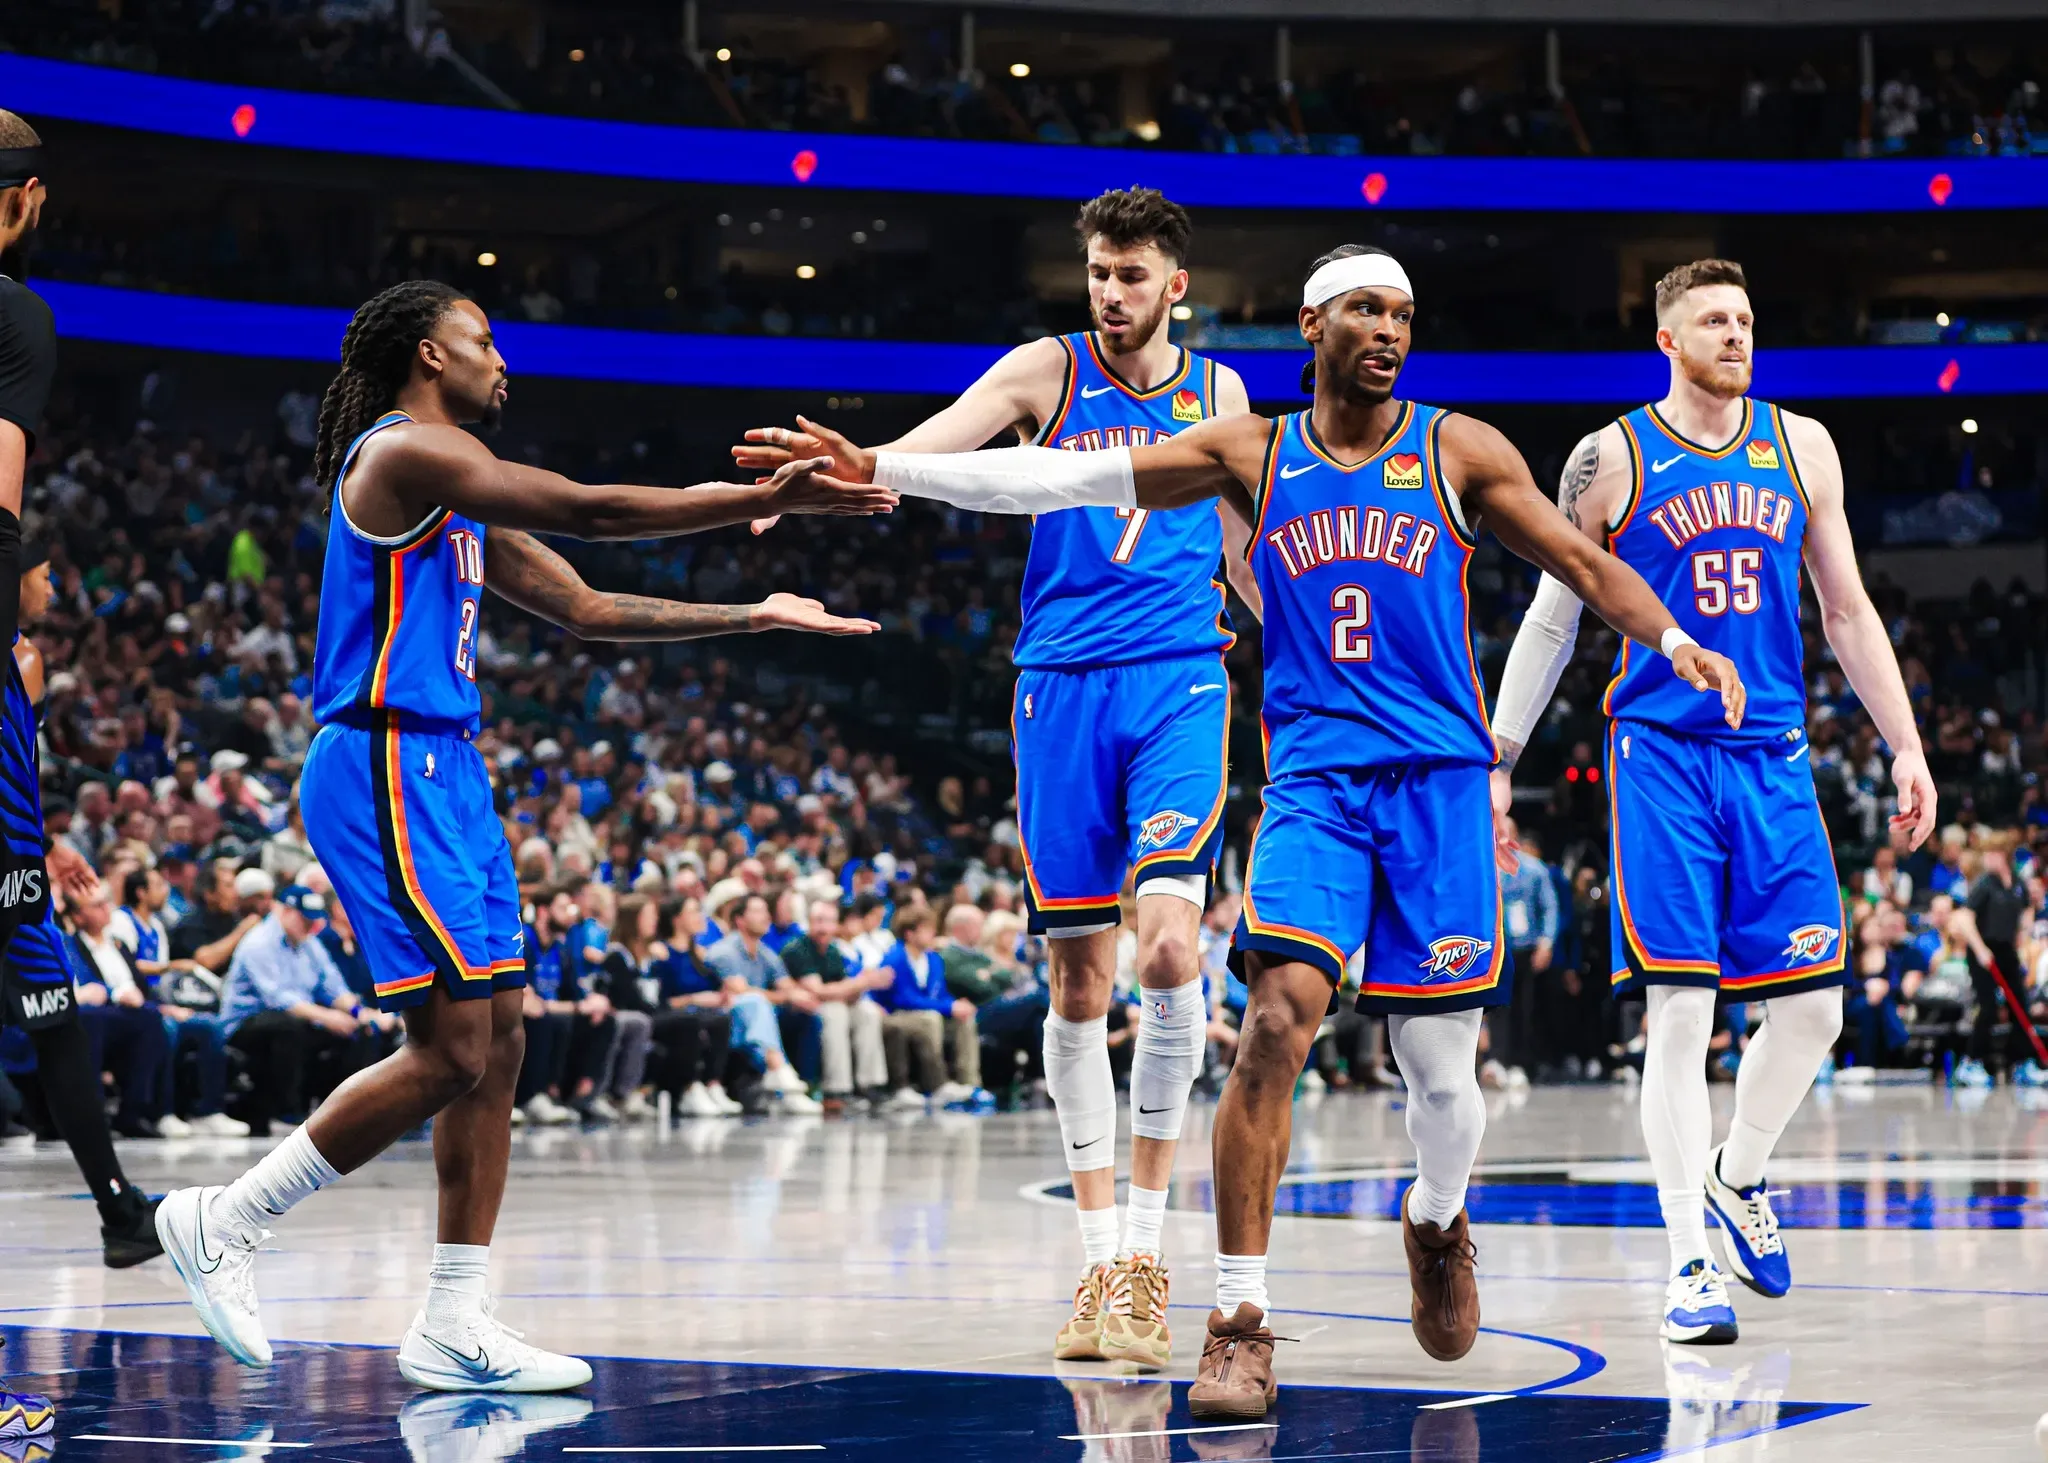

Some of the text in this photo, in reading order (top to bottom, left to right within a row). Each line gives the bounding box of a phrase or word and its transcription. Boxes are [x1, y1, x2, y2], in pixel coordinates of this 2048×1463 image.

[1386, 475, 1421, 486] Love's
[1110, 507, 1151, 564] 7
[1265, 503, 1440, 580] THUNDER
[1648, 481, 1793, 550] THUNDER
[1691, 548, 1763, 617] 55
[1331, 584, 1373, 662] 2
[1433, 943, 1469, 972] OKC
[21, 986, 70, 1020] MAVS
